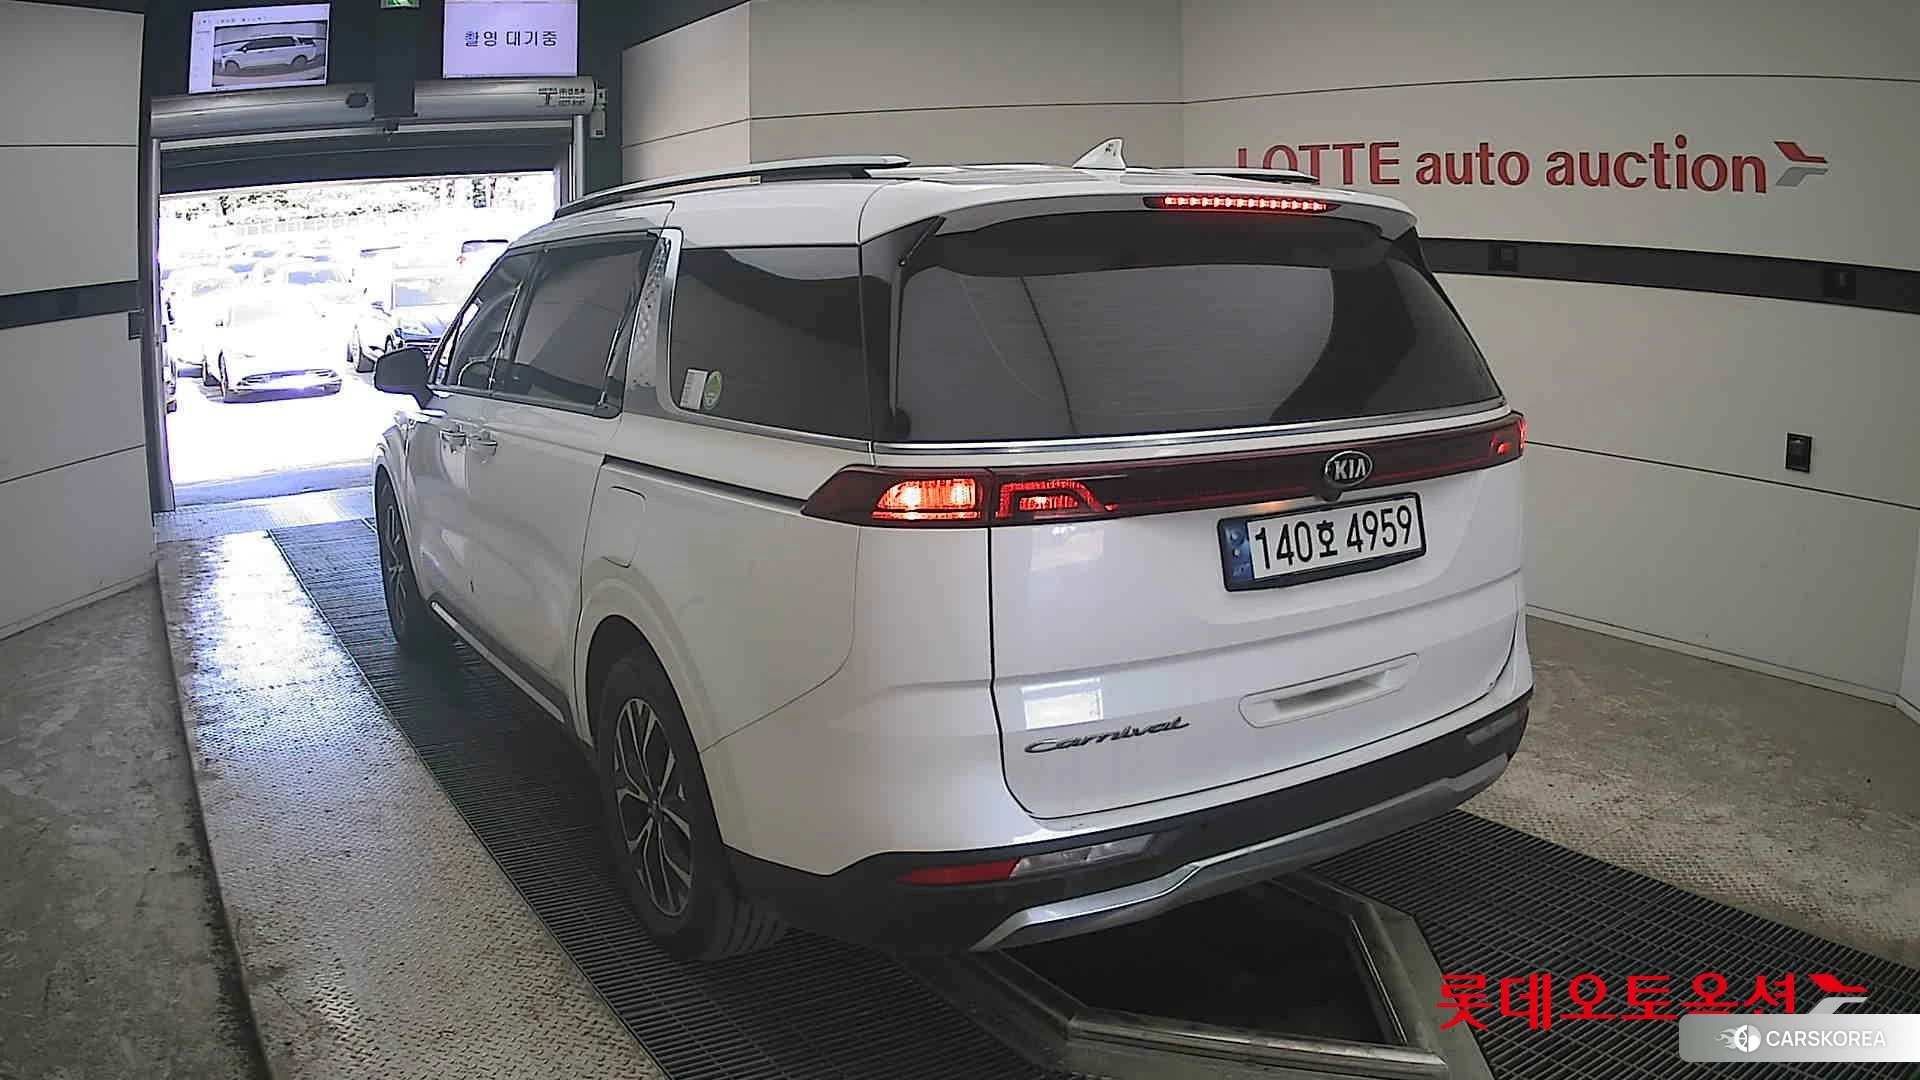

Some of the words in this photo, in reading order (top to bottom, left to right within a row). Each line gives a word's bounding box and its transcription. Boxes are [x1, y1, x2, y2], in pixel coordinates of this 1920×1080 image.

[506, 30, 557, 47] 대기중
[1415, 142, 1530, 186] auto
[1546, 134, 1767, 193] auction
[1334, 459, 1366, 480] KIA
[1255, 520, 1338, 570] 140호
[1346, 505, 1412, 553] 4959
[1024, 716, 1190, 753] Carnival
